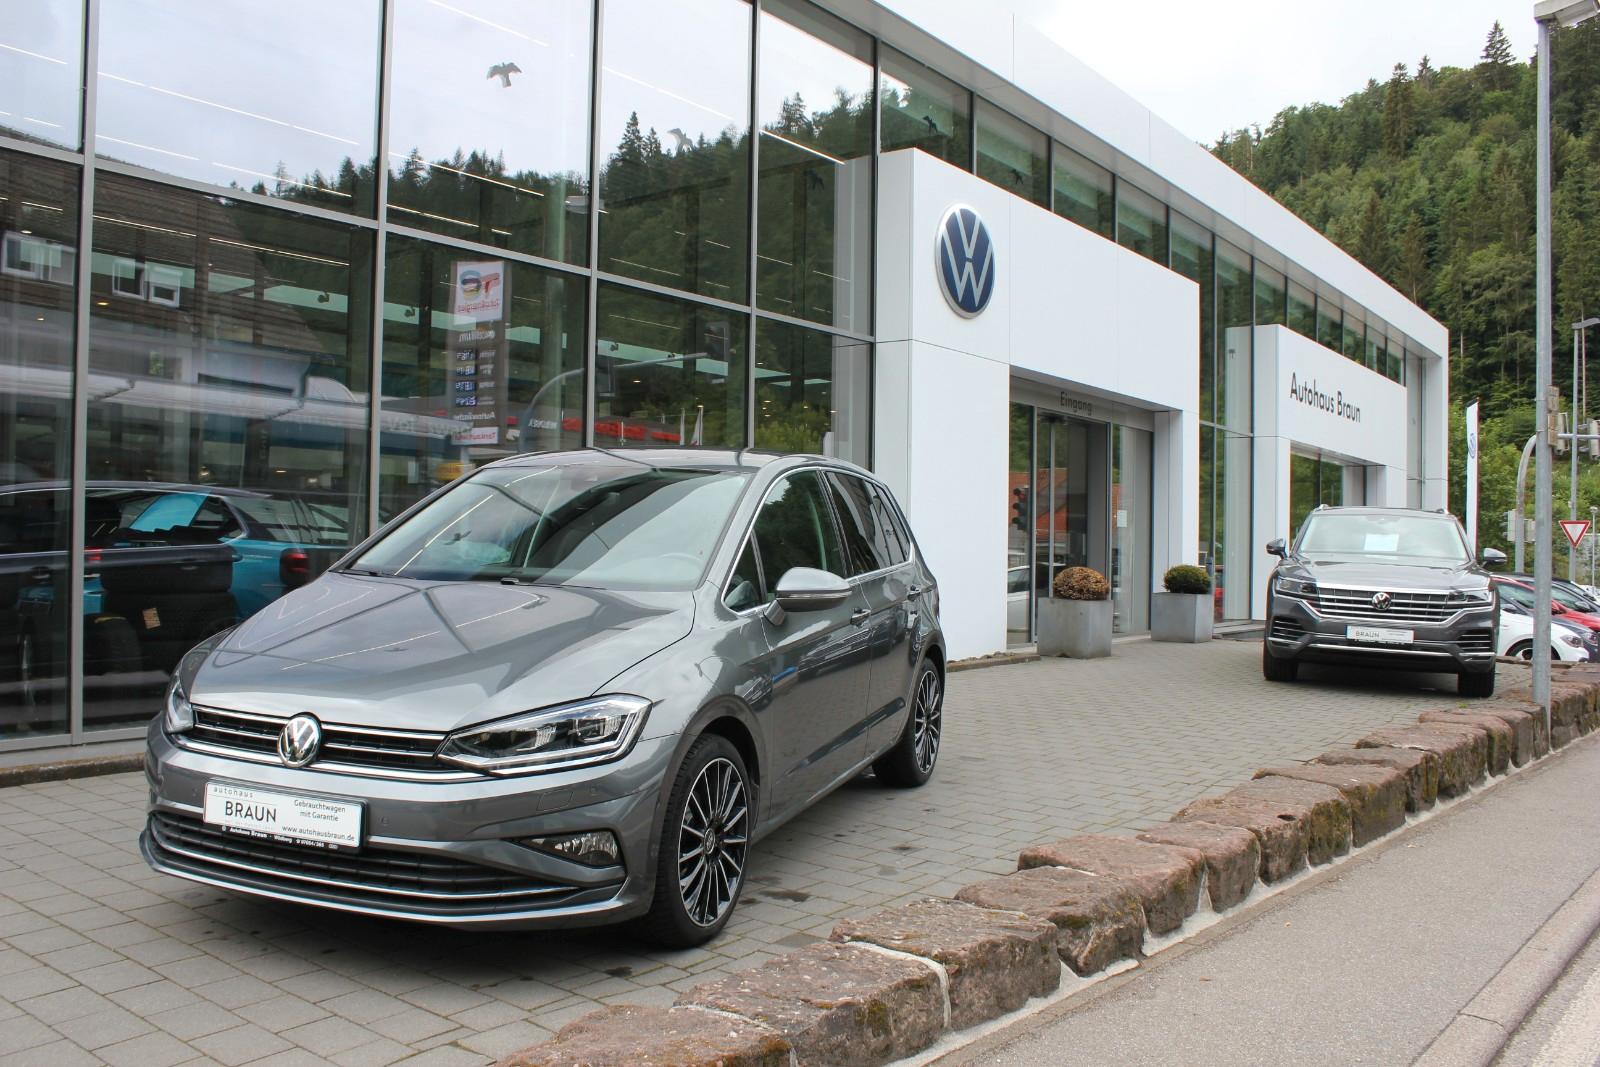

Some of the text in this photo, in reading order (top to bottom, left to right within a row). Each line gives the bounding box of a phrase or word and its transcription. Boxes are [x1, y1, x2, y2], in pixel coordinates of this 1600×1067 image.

[1060, 390, 1093, 417] Eingang
[1290, 371, 1361, 423] Autohaus Braun
[213, 787, 254, 798] autohaus
[225, 801, 276, 822] BRAUN
[294, 799, 346, 814] Gebrauchtwagen
[312, 811, 339, 822] Garantie
[282, 825, 355, 842] www.autohausbraun.de
